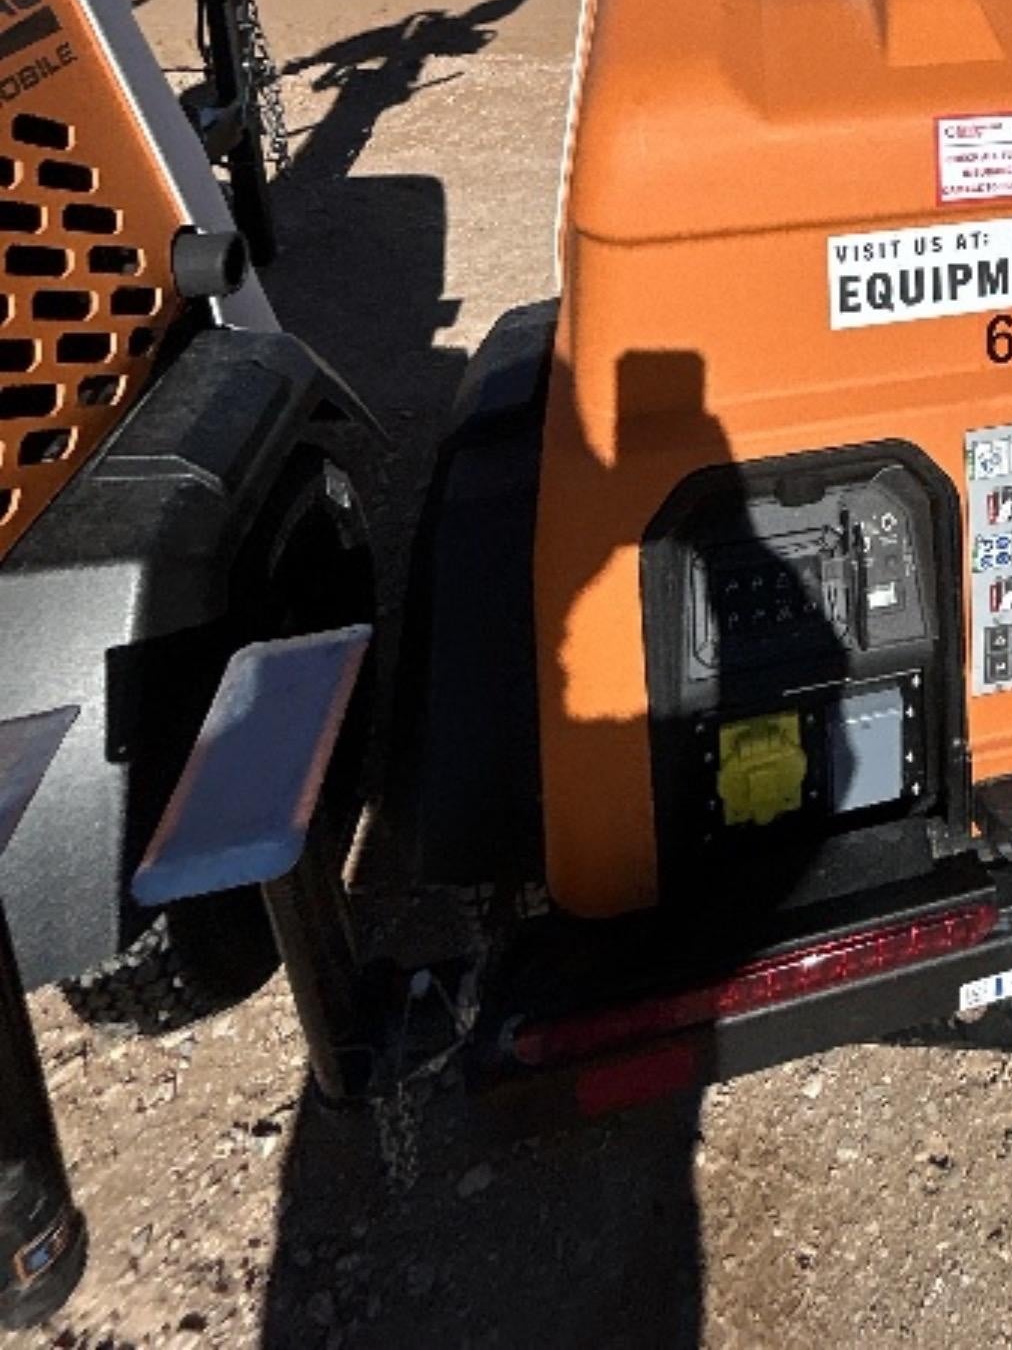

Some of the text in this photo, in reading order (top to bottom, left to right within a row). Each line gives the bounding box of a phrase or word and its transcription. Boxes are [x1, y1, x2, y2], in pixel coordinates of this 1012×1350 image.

[0, 41, 78, 108] OBILE
[835, 231, 989, 264] VISIT US AT:
